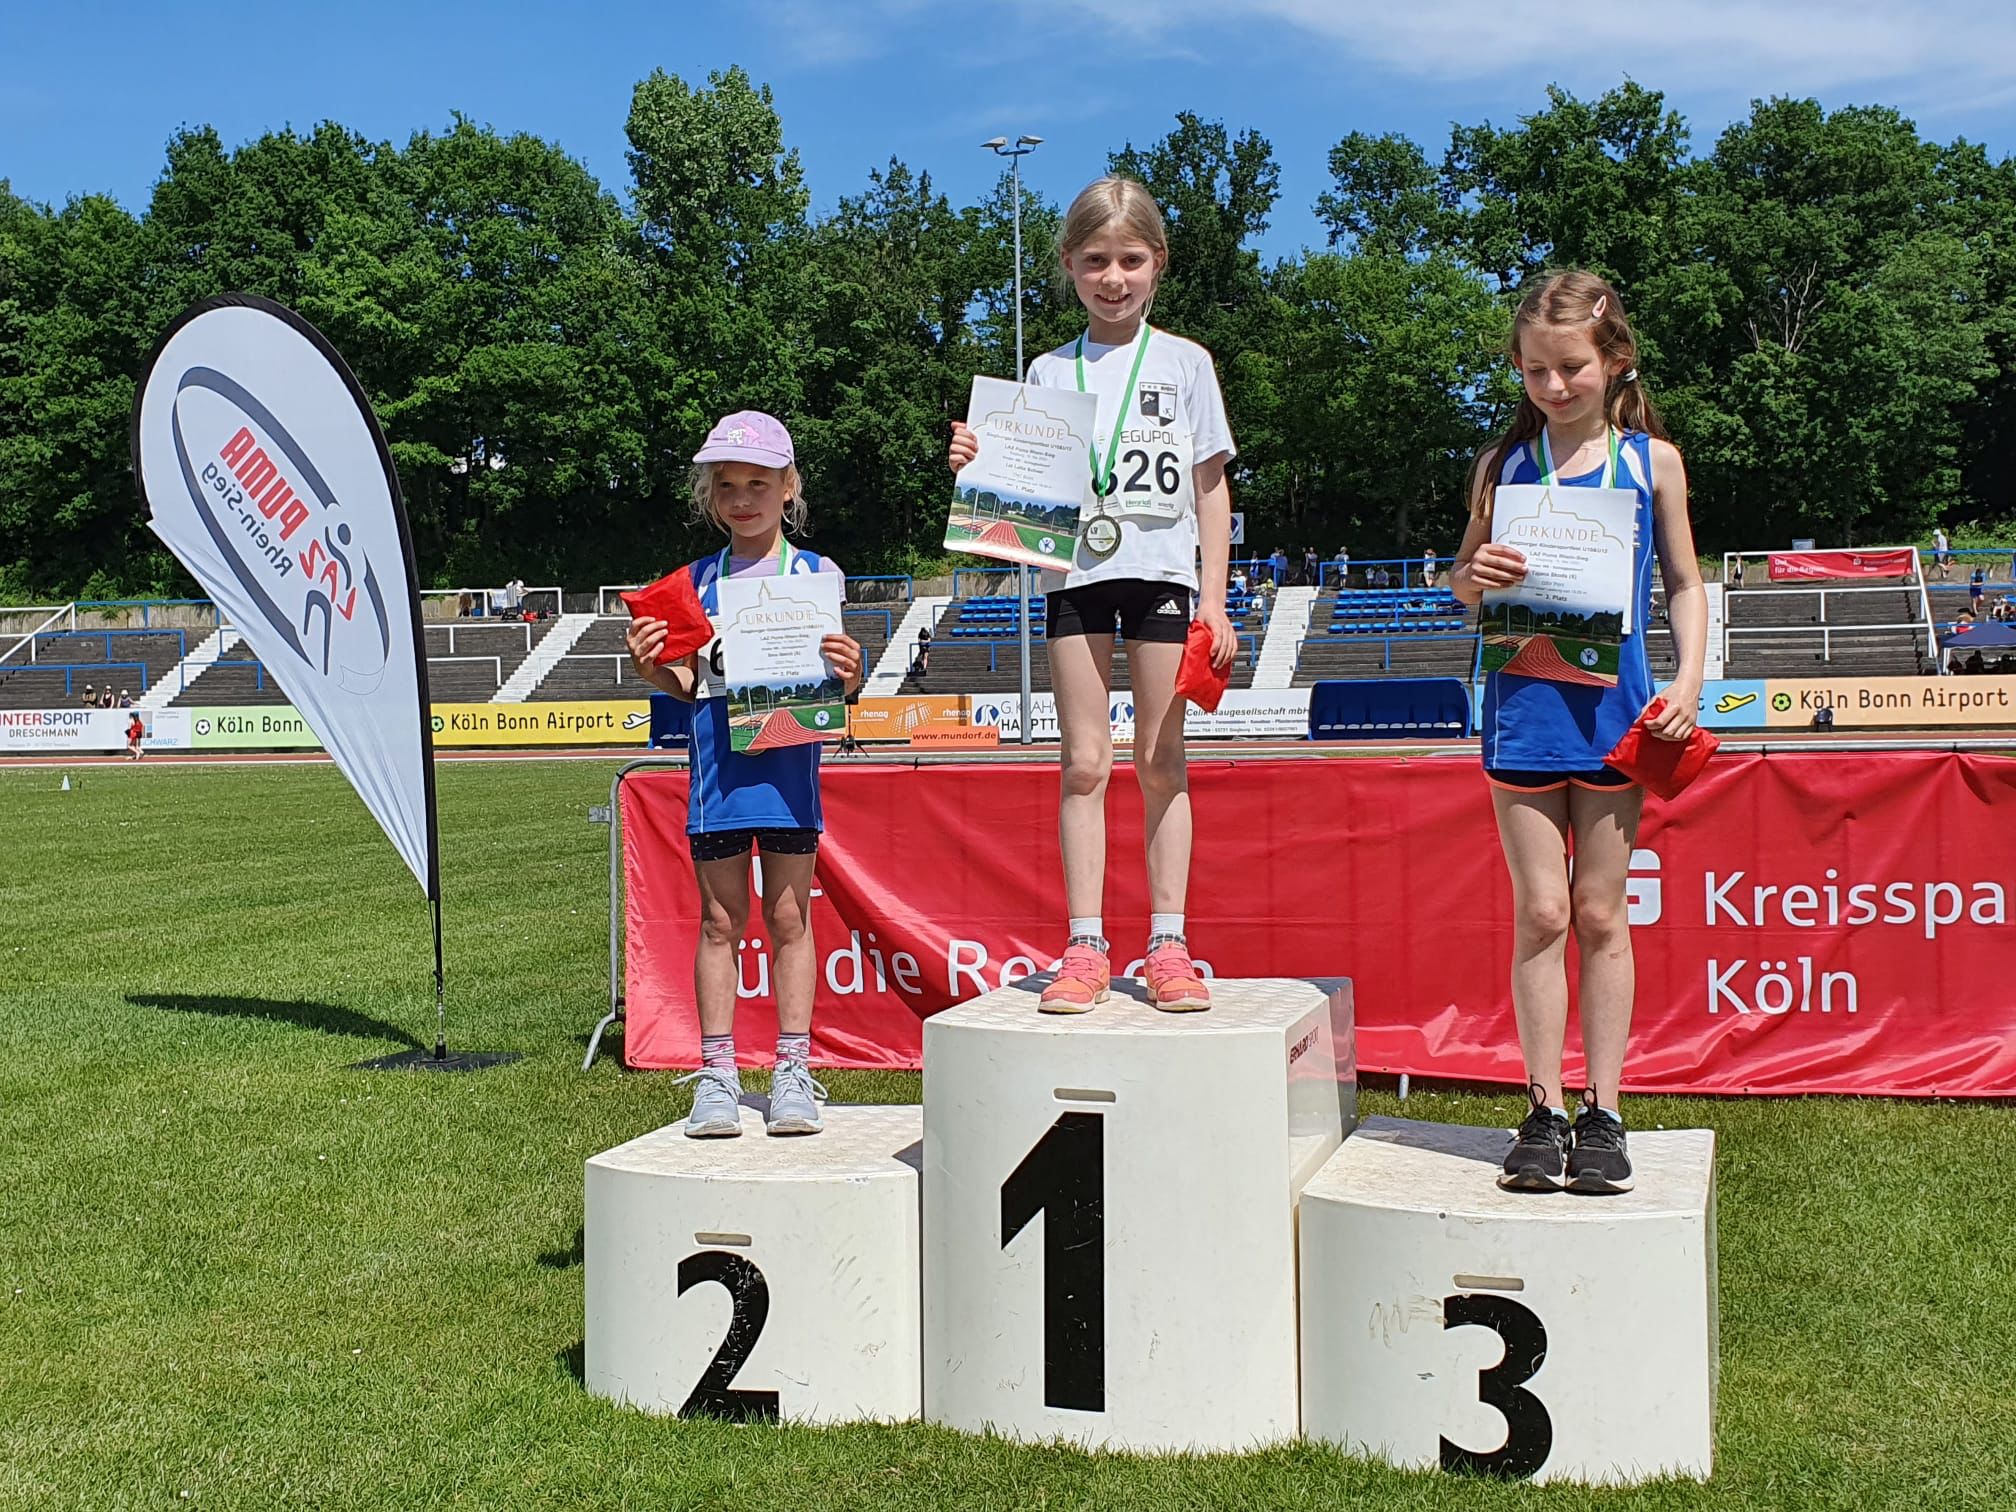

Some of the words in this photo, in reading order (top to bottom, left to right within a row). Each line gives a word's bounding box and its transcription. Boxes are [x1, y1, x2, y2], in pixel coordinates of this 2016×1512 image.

[994, 418, 1065, 440] URKUNDE
[1118, 429, 1179, 447] EGUPOL
[1517, 524, 1599, 542] URKUNDE
[745, 609, 814, 625] URKUNDE
[710, 637, 725, 677] 6
[1800, 690, 1848, 709] Köln
[1859, 689, 1912, 708] Bonn
[1923, 687, 2009, 712] Airport
[0, 712, 92, 726] INTERSPORT
[451, 713, 489, 730] Köln
[497, 712, 539, 730] Bonn
[547, 711, 615, 733] Airport
[860, 710, 889, 719] rhenag
[942, 708, 971, 718] rhenag
[9, 728, 79, 738] DRESCHMANN
[217, 716, 254, 733] Köln
[262, 716, 303, 733] Bonn
[1001, 719, 1060, 731] HAPTT
[143, 738, 178, 746] CHWARZ
[912, 731, 997, 741] www.mundorf.de
[1704, 868, 2006, 940] Kreisspa
[825, 929, 923, 995] die
[1706, 955, 1858, 1016] Köln
[1000, 1111, 1105, 1413] 1
[677, 1250, 780, 1426] 2
[1439, 1293, 1553, 1482] 3
